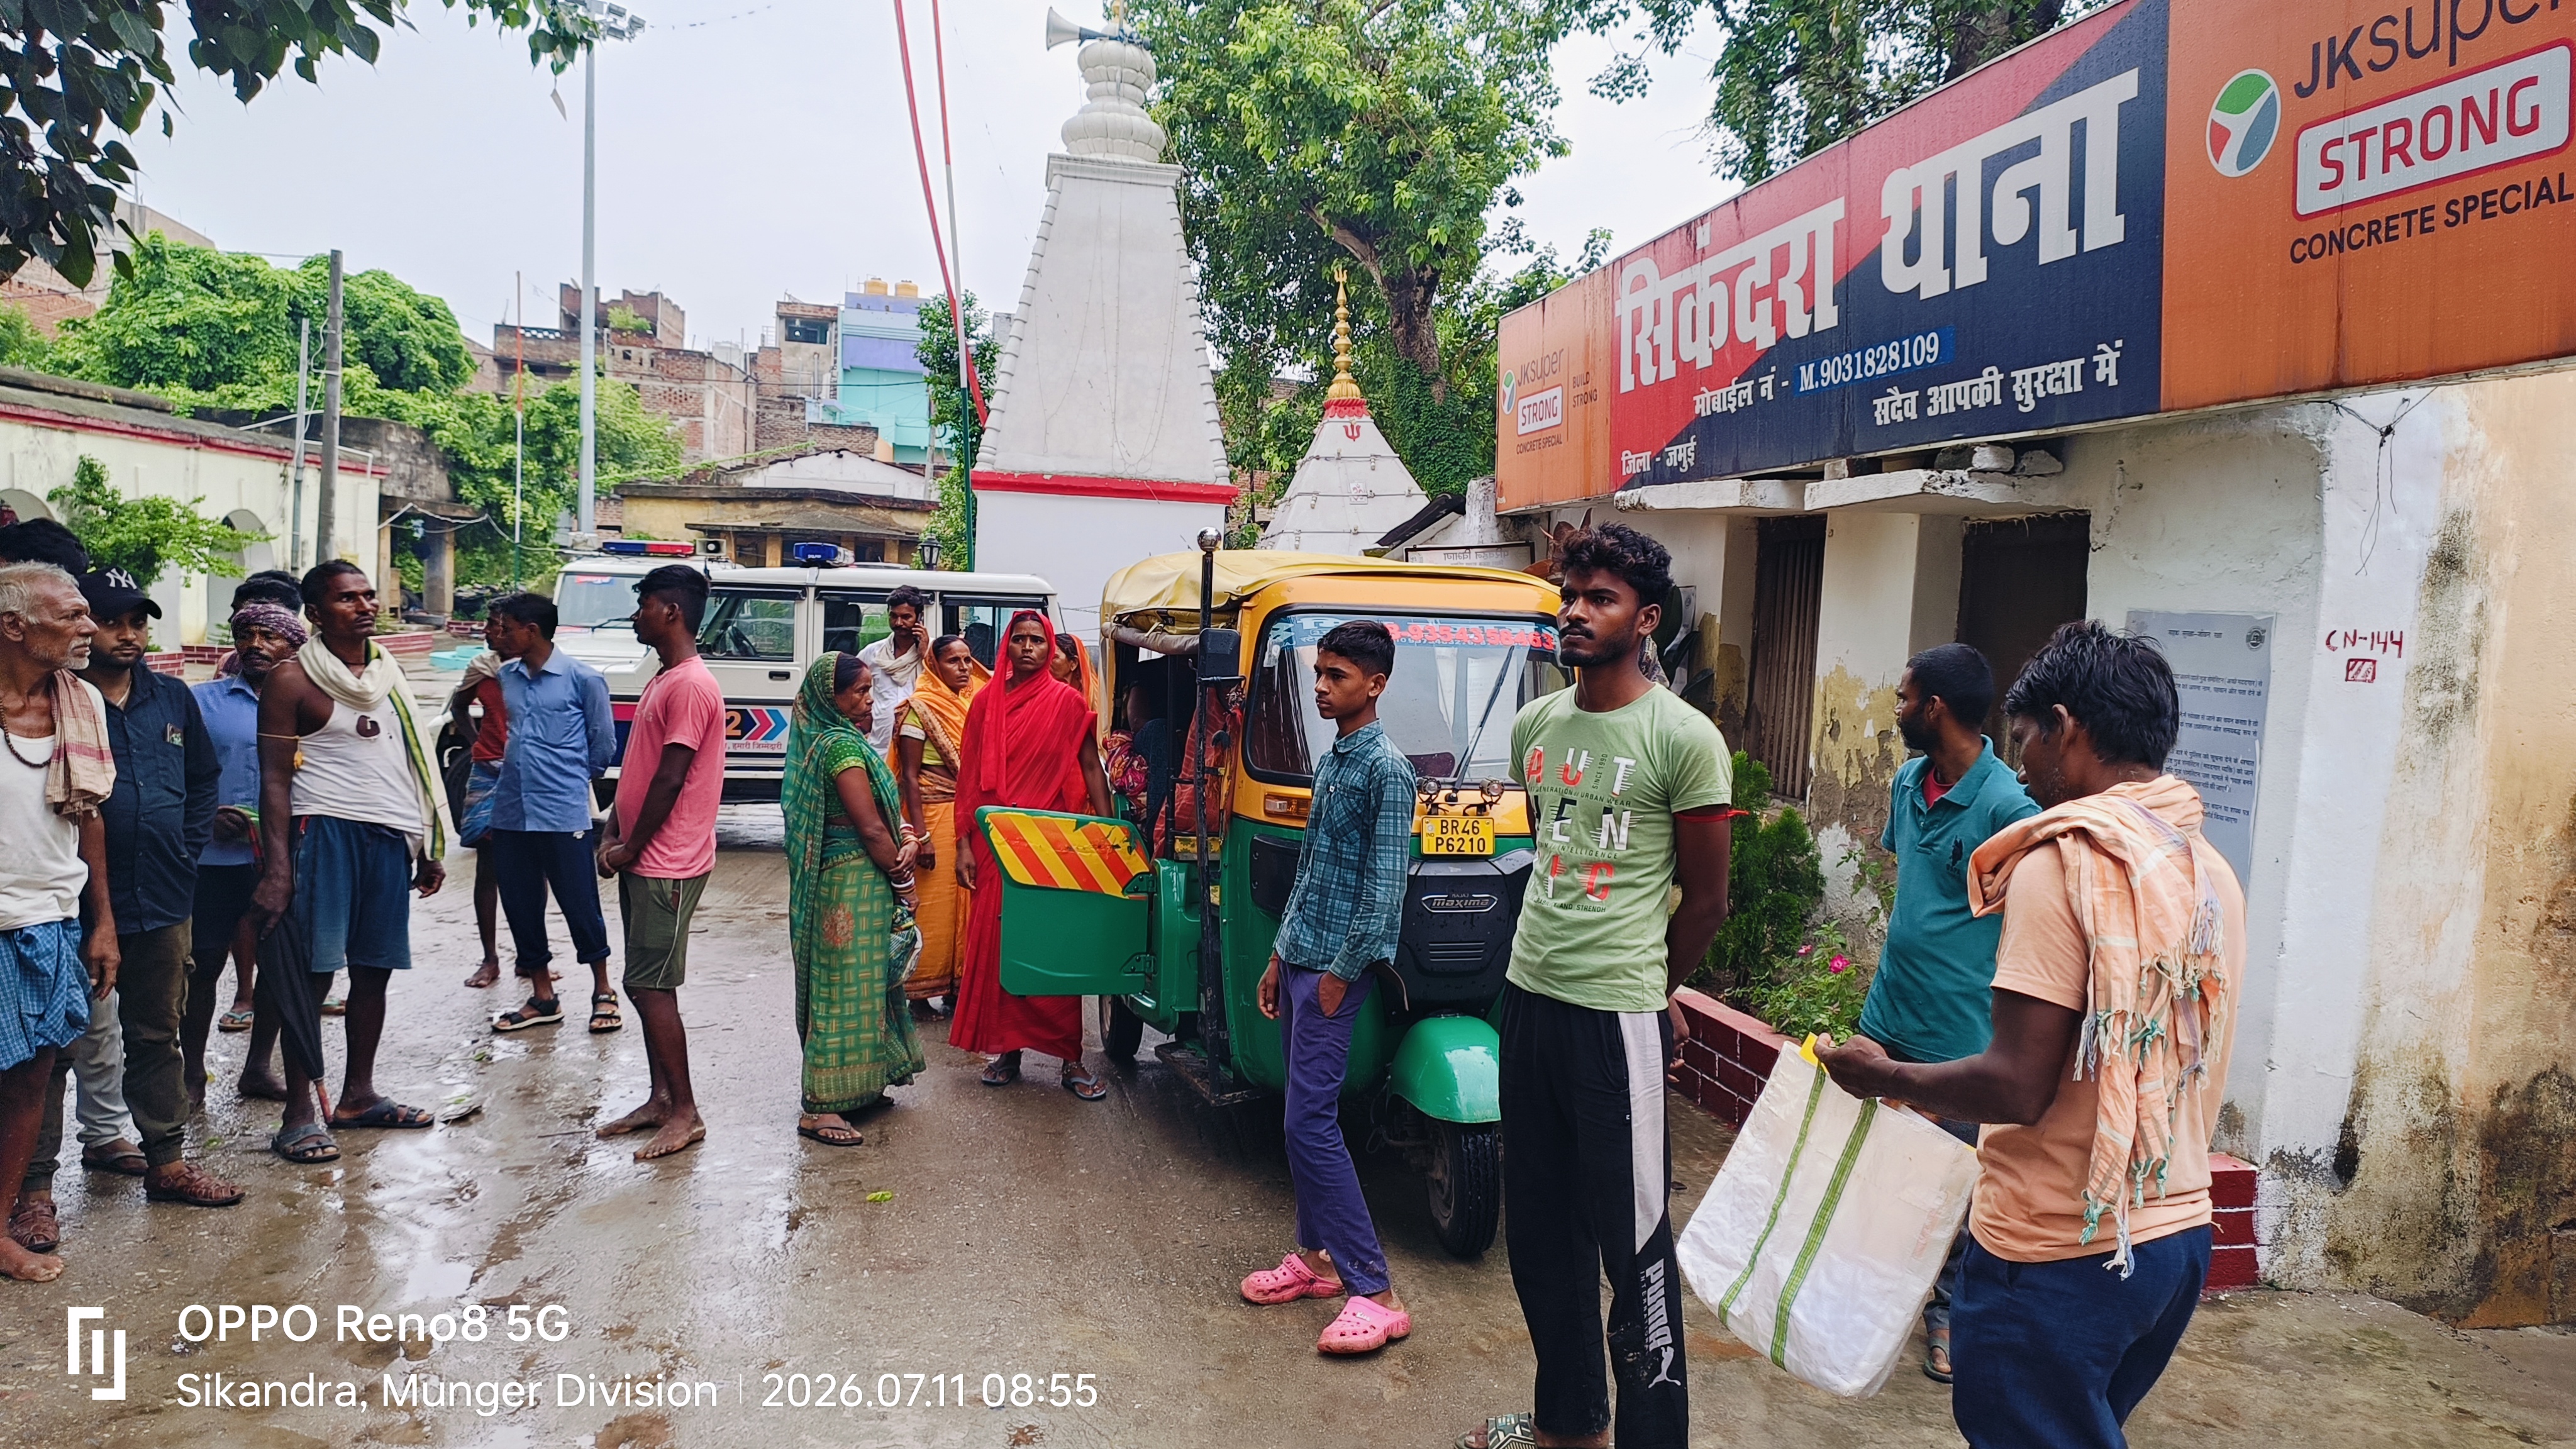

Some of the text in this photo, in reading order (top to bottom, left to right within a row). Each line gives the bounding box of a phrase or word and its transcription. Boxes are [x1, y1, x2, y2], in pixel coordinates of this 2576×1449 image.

[2294, 0, 2559, 99] JKsup
[2319, 75, 2541, 191] STRONG
[1615, 67, 2139, 394] सिकंदरा थाना
[2290, 172, 2575, 264] CONCRETE SPECIAL
[1573, 372, 1590, 389] BUILD
[1693, 377, 1755, 417] मोबाईल
[1799, 331, 1940, 392] M.9031828109
[1873, 339, 2123, 426] सदैव आपकी सुरक्षा में
[1521, 396, 1558, 426] STRONG
[1573, 389, 1597, 408] STRONG
[1516, 433, 1563, 455] CONCRETE SPECIAL
[1621, 450, 1652, 476] जिला
[1665, 435, 1697, 472] जमुई
[732, 741, 751, 750] हमारी
[1592, 753, 1608, 789] SINCE 1990
[1580, 792, 1604, 803] URBAN
[1607, 797, 1631, 807] WEAR
[1436, 837, 1486, 853] P6210
[1440, 819, 1480, 835] BR46
[1646, 1258, 1673, 1352] PUMA
